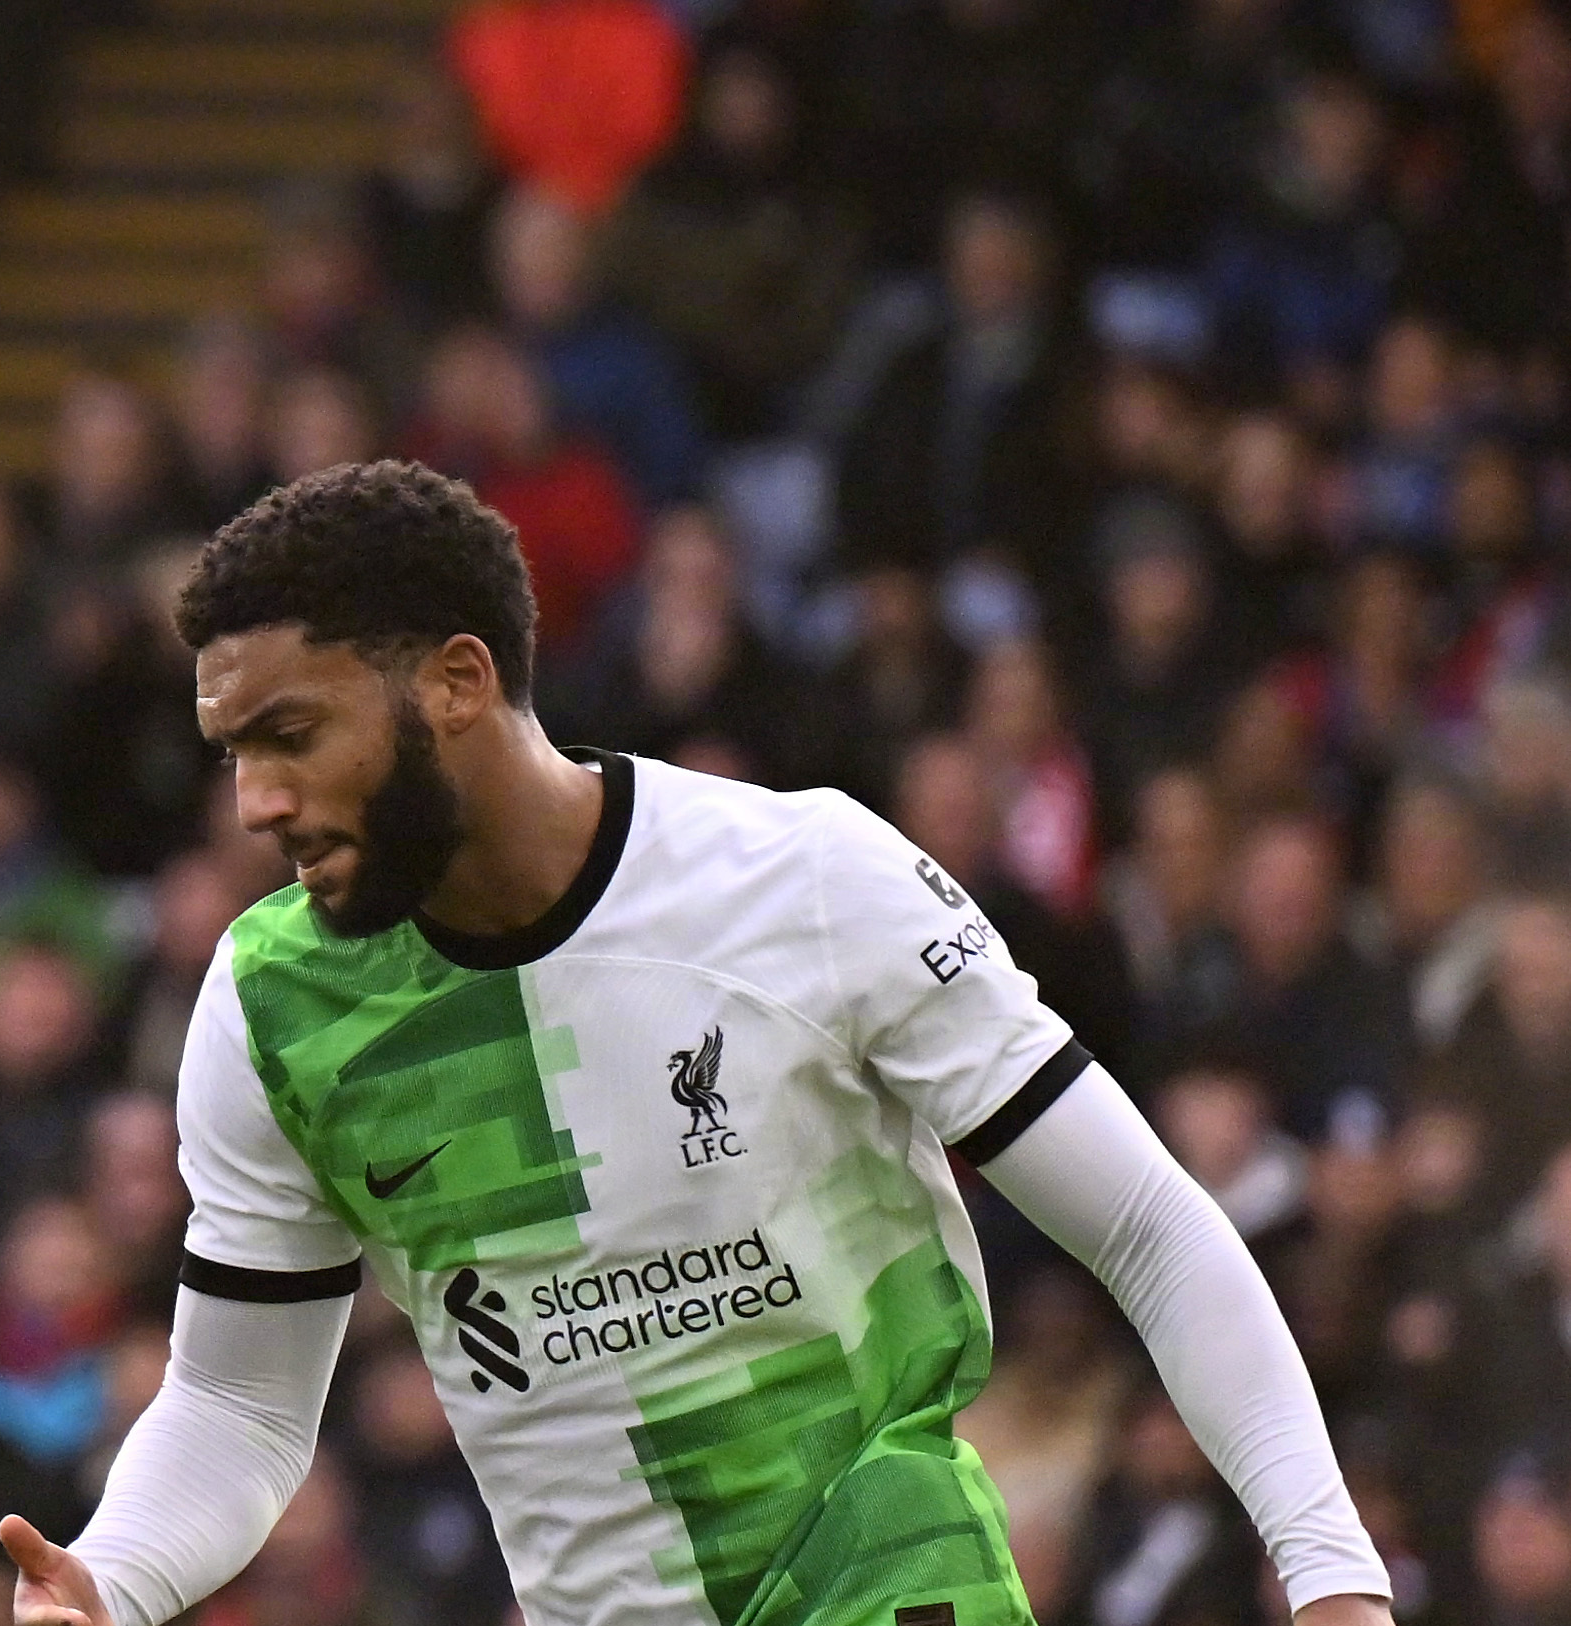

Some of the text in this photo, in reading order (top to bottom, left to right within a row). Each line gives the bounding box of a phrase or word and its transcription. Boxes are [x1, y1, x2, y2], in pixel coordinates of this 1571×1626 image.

[680, 1132, 749, 1168] L.F.C.
[531, 1227, 771, 1319] standard
[543, 1263, 802, 1365] chartered
